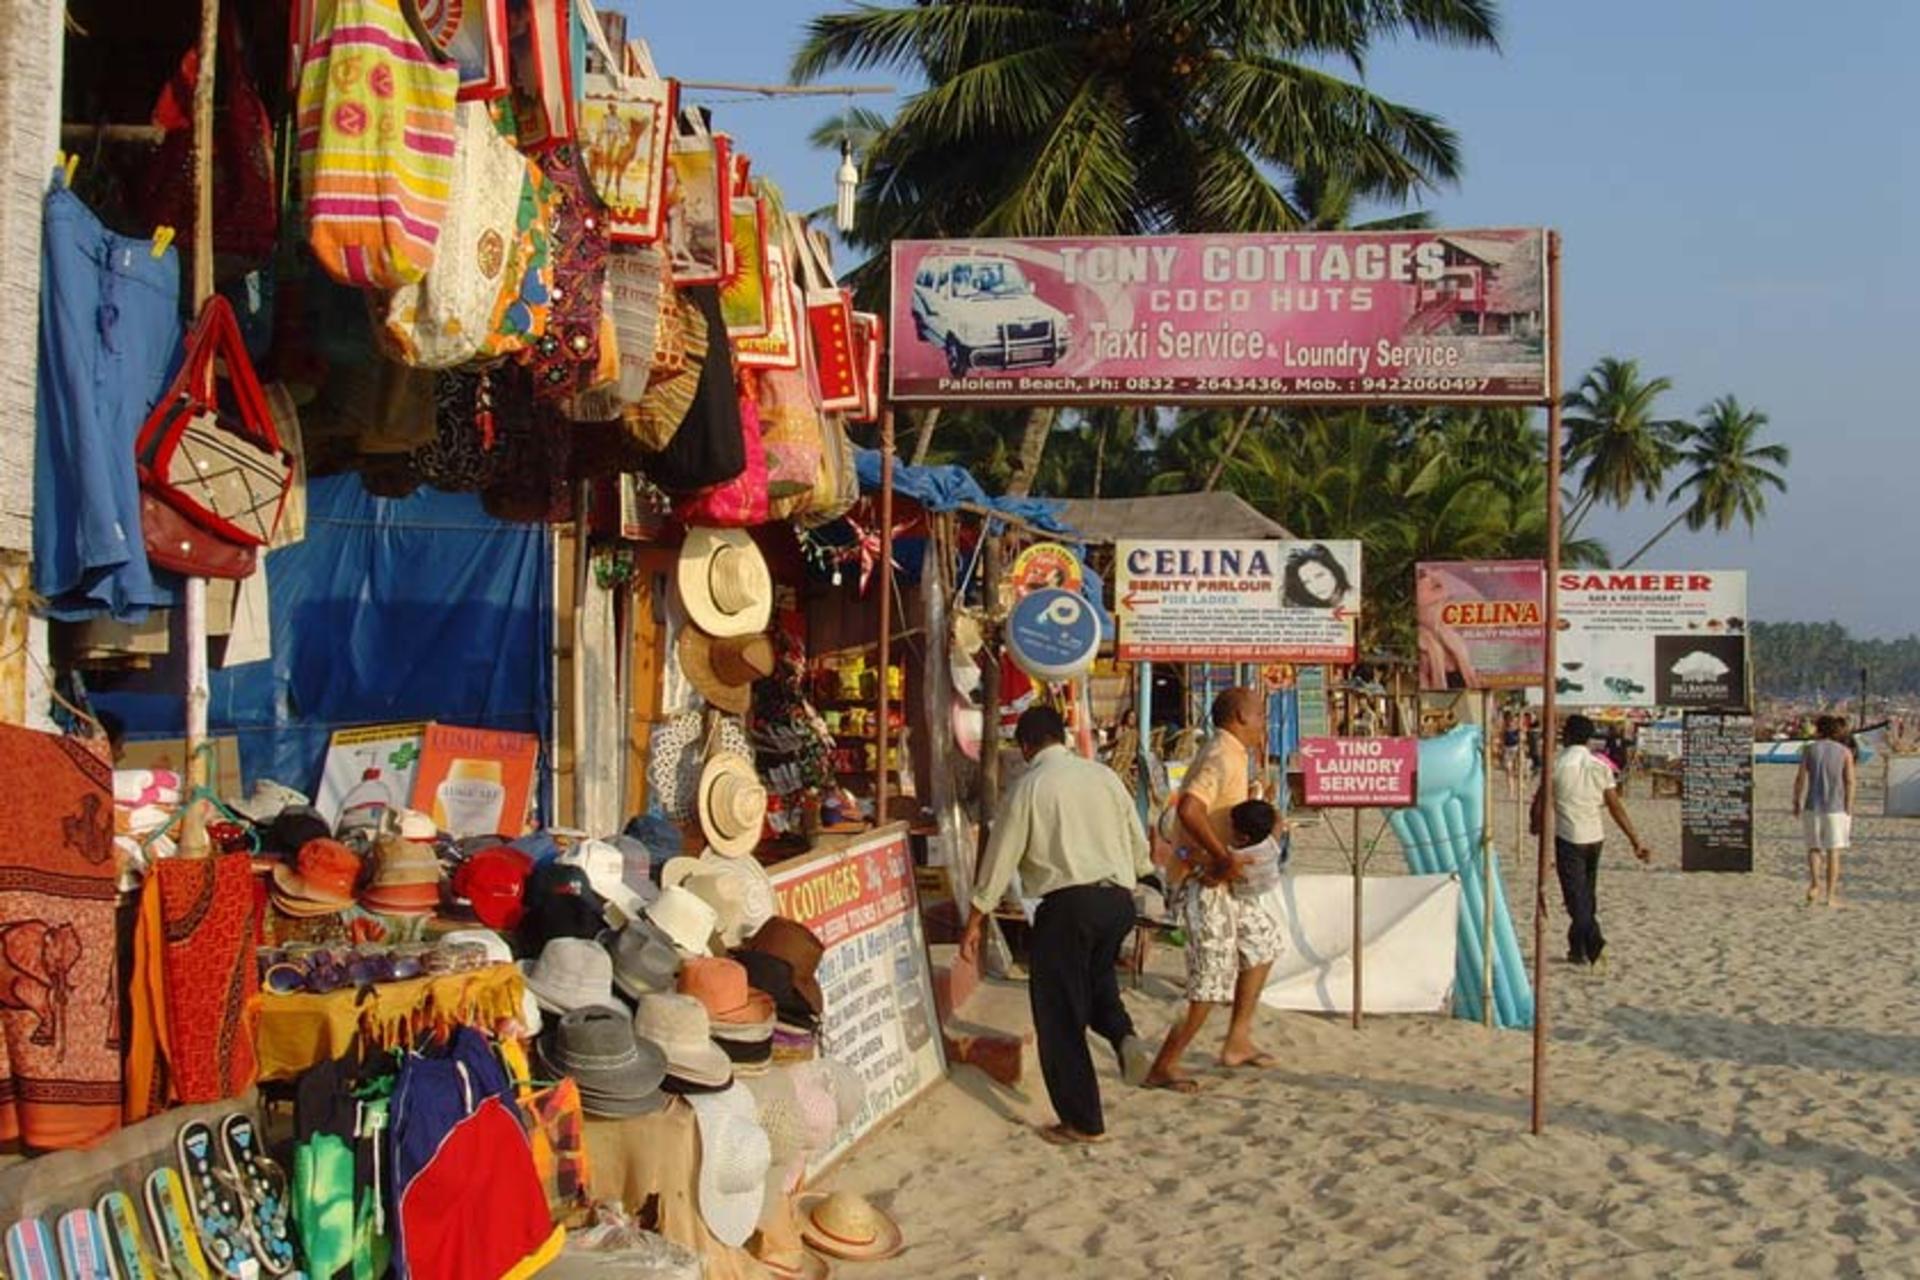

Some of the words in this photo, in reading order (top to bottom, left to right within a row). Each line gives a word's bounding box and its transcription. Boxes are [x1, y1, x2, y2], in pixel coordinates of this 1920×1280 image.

[1060, 246, 1177, 284] TONY
[1203, 241, 1446, 283] COTTAGES
[1150, 288, 1249, 312] COCO
[1270, 287, 1373, 312] HUTS
[1091, 320, 1148, 359] Taxi
[1157, 320, 1264, 359] Service
[1283, 339, 1370, 374] Loundry
[1377, 338, 1458, 367] Service
[939, 378, 1013, 391] Palolem
[1020, 378, 1083, 393] Beach,
[1088, 378, 1120, 391] Ph:
[1126, 378, 1174, 391] 0832
[1196, 378, 1288, 393] 2643436,
[1362, 377, 1490, 391] 9422060497
[1127, 549, 1271, 575] CELINA
[1129, 580, 1192, 591] BEAUTY
[1197, 580, 1272, 592] PARLOUR
[1559, 574, 1713, 591] SAMEER
[1162, 594, 1188, 604] FOR
[1191, 594, 1240, 604] LADIES
[1441, 602, 1540, 625] CELINA
[1336, 741, 1382, 756] TINO
[1315, 758, 1404, 774] LAUNDRY
[1319, 776, 1400, 792] SERVICE
[792, 863, 861, 922] COTTAGES
